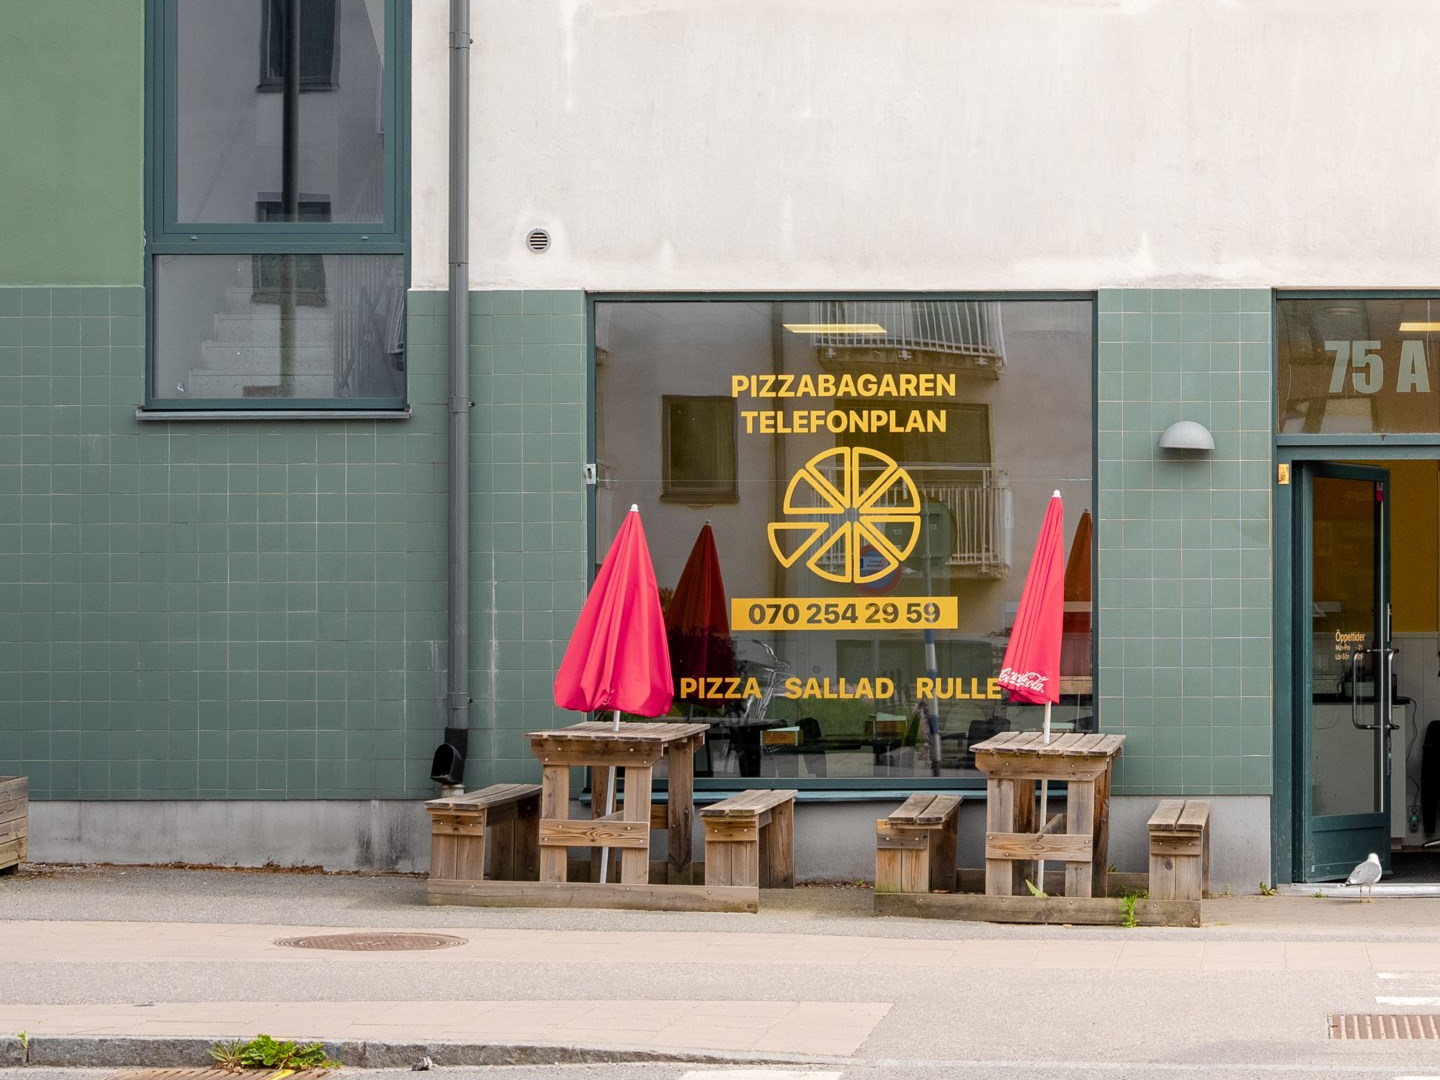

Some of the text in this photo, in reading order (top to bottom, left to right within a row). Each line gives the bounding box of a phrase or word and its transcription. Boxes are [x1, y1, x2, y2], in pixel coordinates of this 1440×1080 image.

[1324, 340, 1430, 394] 75 A
[731, 373, 956, 398] PIZZABAGAREN
[740, 409, 947, 434] TELEFONPLAN
[748, 602, 941, 625] 070 254 29 59
[680, 677, 1002, 700] PIZZA SALLAD RULLE
